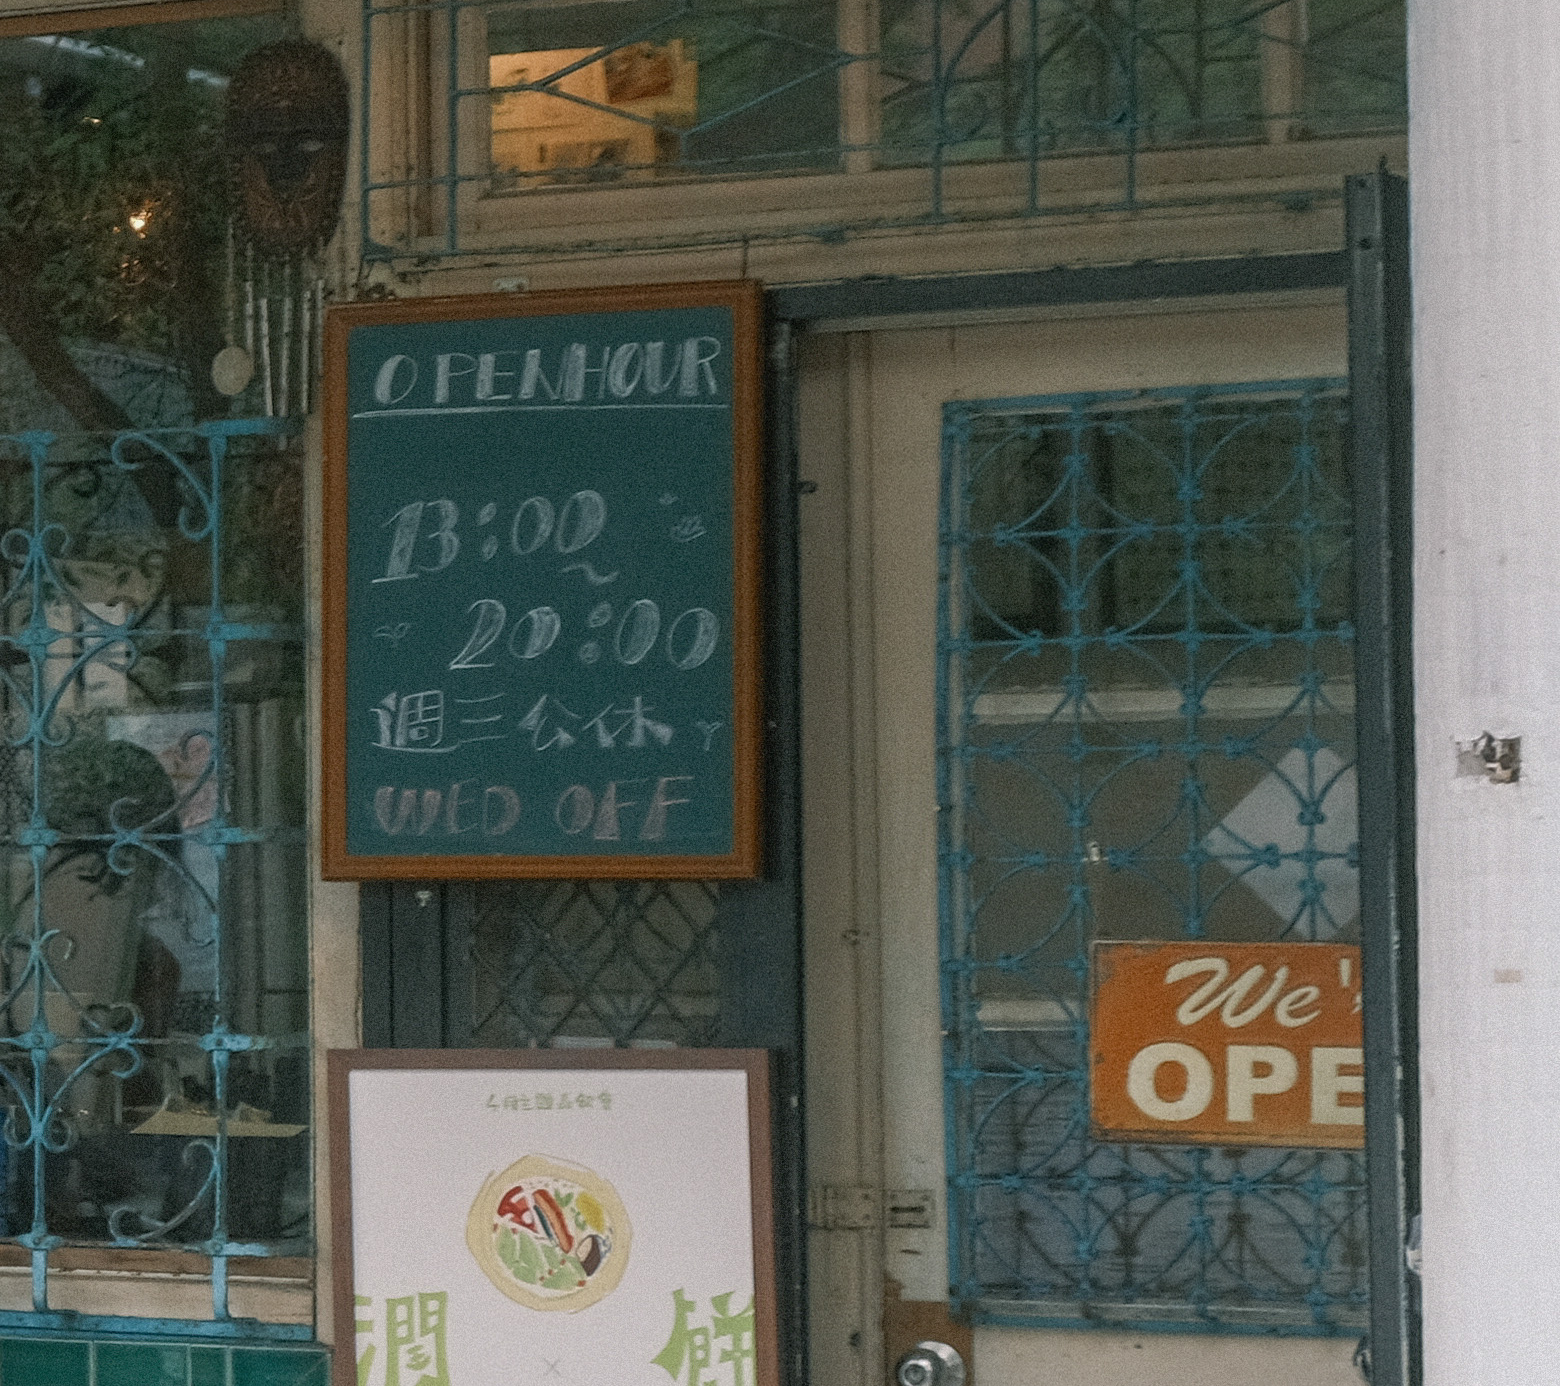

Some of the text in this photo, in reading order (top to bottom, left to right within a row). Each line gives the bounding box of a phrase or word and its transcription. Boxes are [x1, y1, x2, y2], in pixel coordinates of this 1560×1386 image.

[449, 600, 719, 669] 20:00
[370, 690, 674, 752] 週三公休
[373, 777, 695, 840] WED OFF
[1166, 958, 1362, 1028] We'
